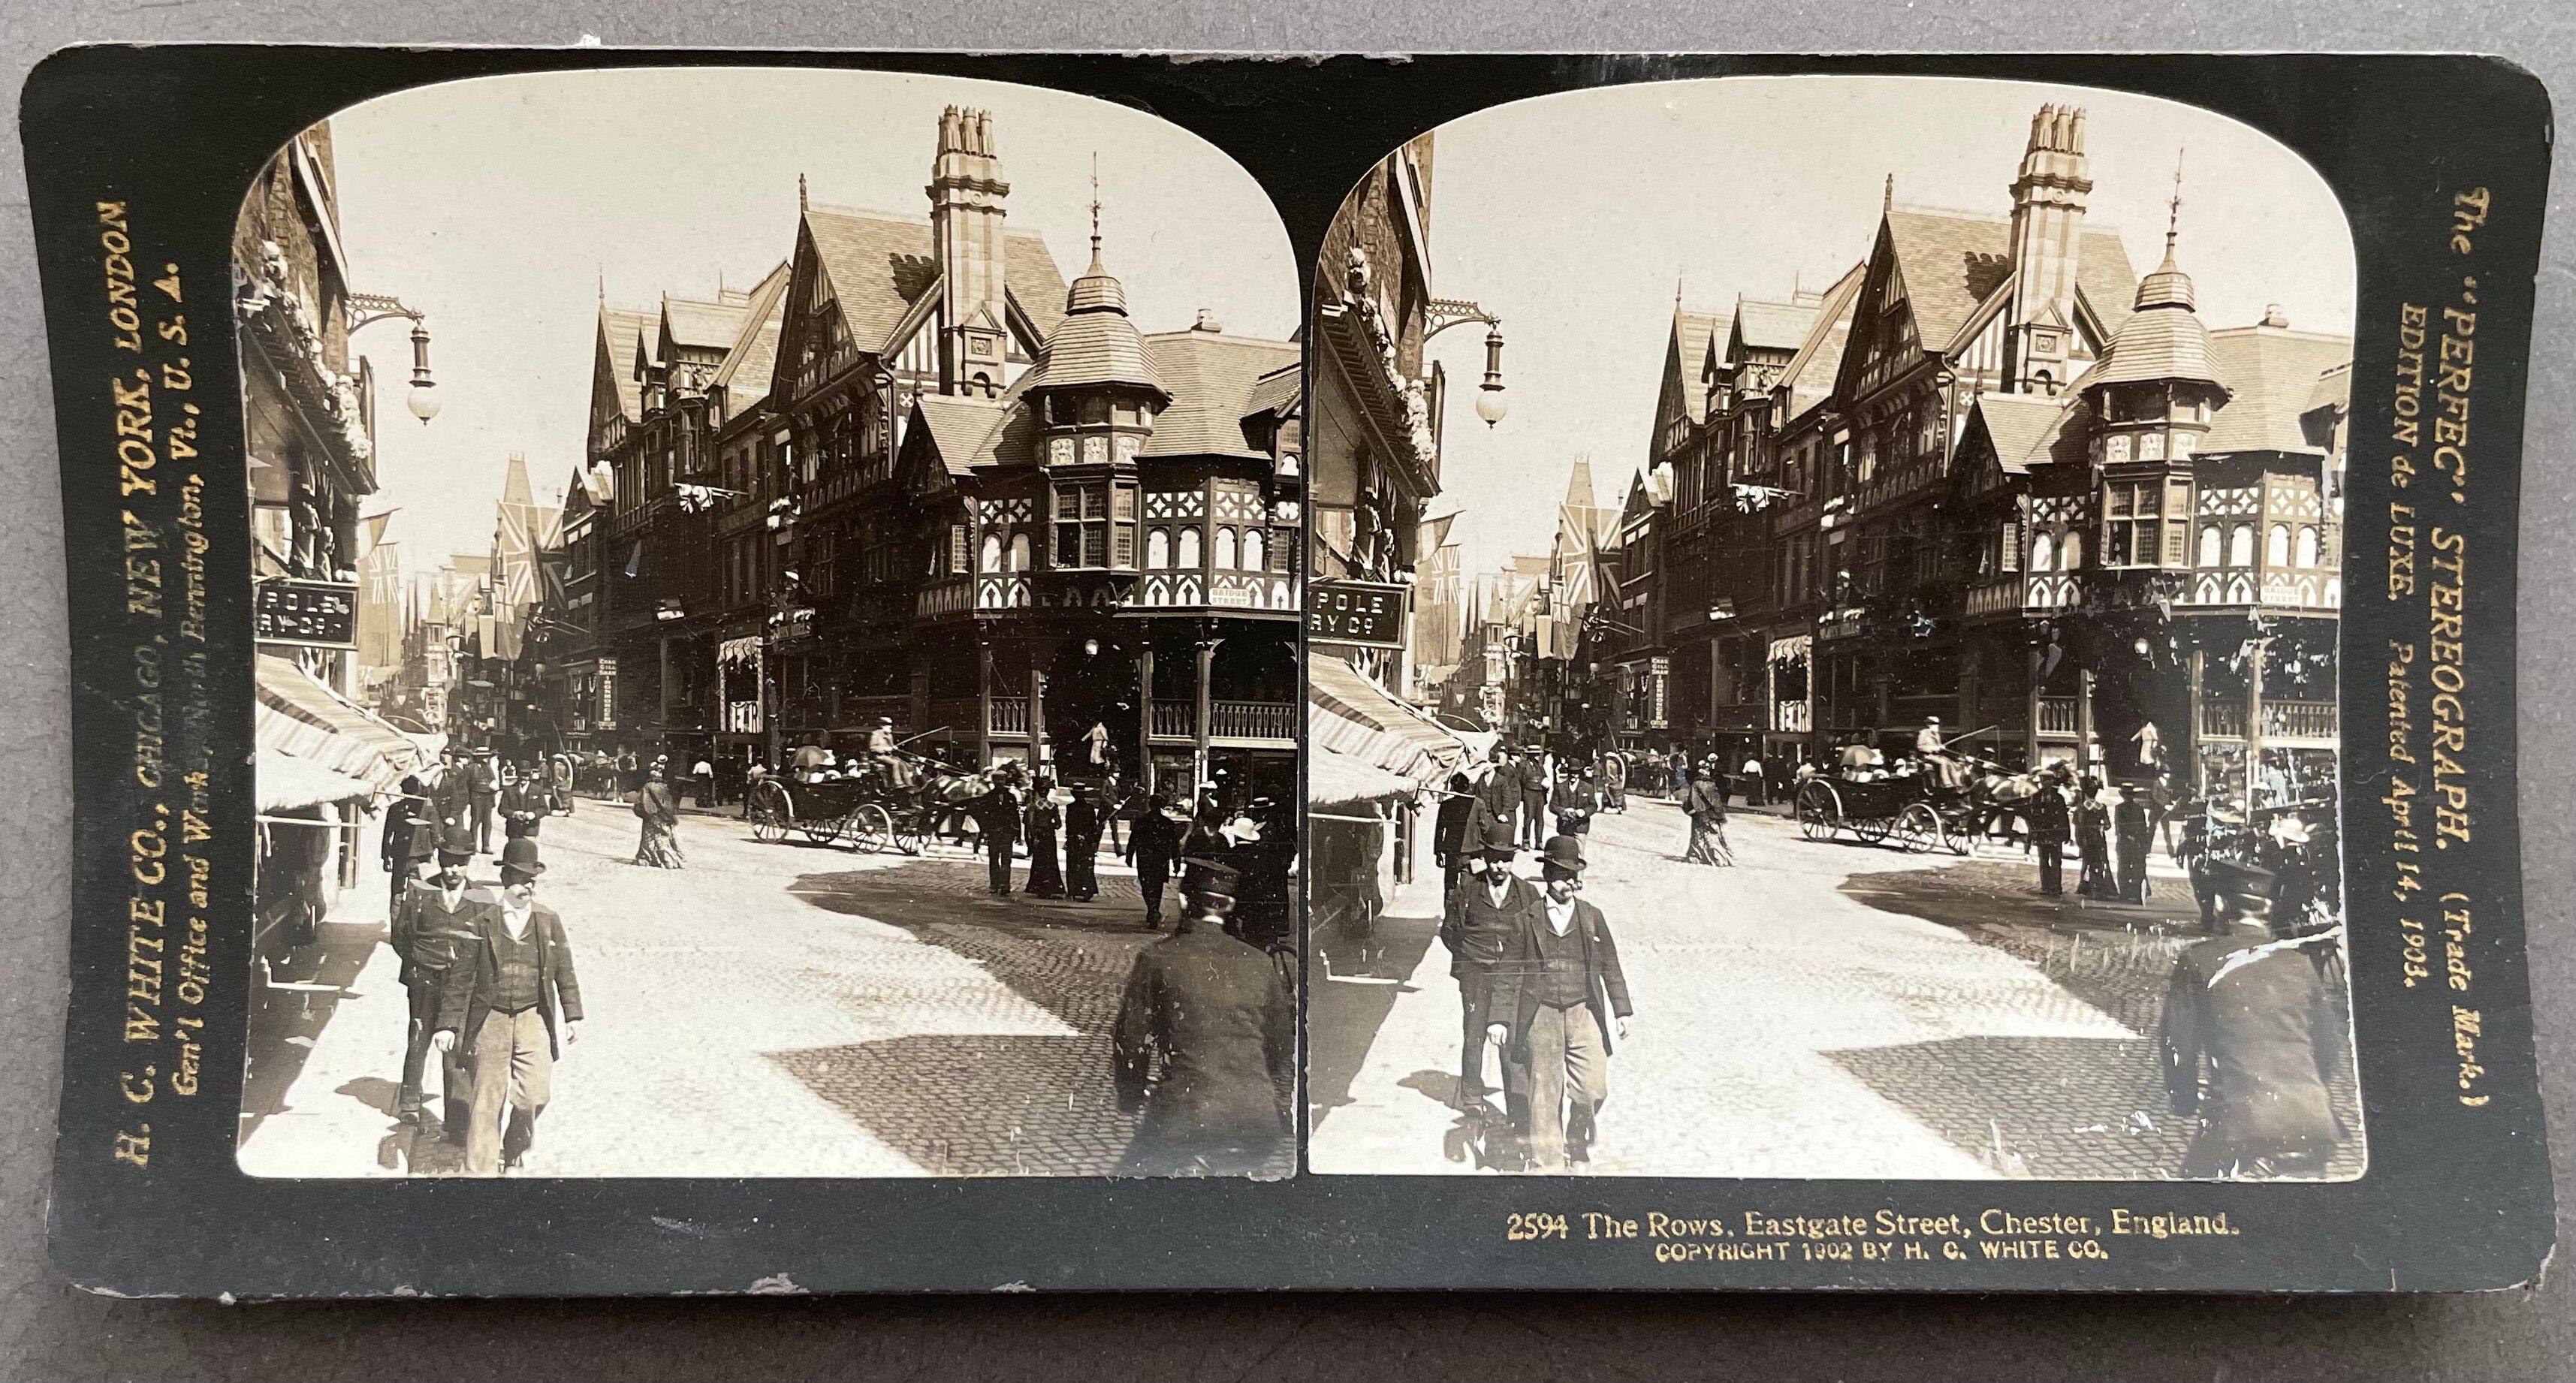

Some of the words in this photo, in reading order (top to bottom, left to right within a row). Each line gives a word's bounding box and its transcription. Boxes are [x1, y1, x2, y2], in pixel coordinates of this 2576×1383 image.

[2449, 188, 2489, 255] The
[96, 200, 143, 352] LONDON
[153, 262, 182, 302] A.
[158, 315, 187, 345] S.
[162, 357, 192, 390] U.
[2390, 303, 2426, 447] EDITION
[112, 367, 157, 495] YORK,
[168, 402, 201, 459] Vt.,
[2390, 455, 2415, 488] de
[121, 508, 167, 617] NEW
[177, 473, 209, 641] Bennington,
[2387, 502, 2415, 601] LUXE.
[1212, 589, 1247, 598] BRIDGE
[1212, 597, 1247, 605] STREET
[1308, 592, 1383, 613] POLE
[134, 634, 168, 788] CHICAGO,
[2387, 638, 2415, 764] Patented
[2430, 527, 2470, 850] STEREOGRAPH.
[131, 803, 170, 884] CO.,
[2381, 776, 2419, 853] April
[182, 852, 209, 907] and
[2392, 861, 2421, 902] 14,
[124, 897, 165, 1041] WHITE
[177, 916, 210, 1003] Office
[2397, 917, 2427, 988] 1903.
[2439, 893, 2470, 992] (Trade
[121, 1063, 156, 1102] C.
[171, 1016, 204, 1095] Gen'l
[2450, 1005, 2489, 1107] Mark.)
[113, 1122, 150, 1165] H.
[1507, 1213, 1569, 1240] 2594
[1581, 1211, 1639, 1240] The
[1745, 1210, 1869, 1240] Eastgate
[1875, 1208, 1972, 1239] Street,
[1980, 1208, 2101, 1237] Chester,
[2110, 1208, 2240, 1240] England.
[1655, 1241, 1790, 1264] COPYRIGHT
[1802, 1241, 1854, 1263] 1902
[1862, 1241, 1893, 1262] BY
[1904, 1241, 1930, 1261] H.
[1942, 1240, 1968, 1261] C.
[1979, 1240, 2061, 1261] WHITE
[2067, 1239, 2109, 1261] CO.
